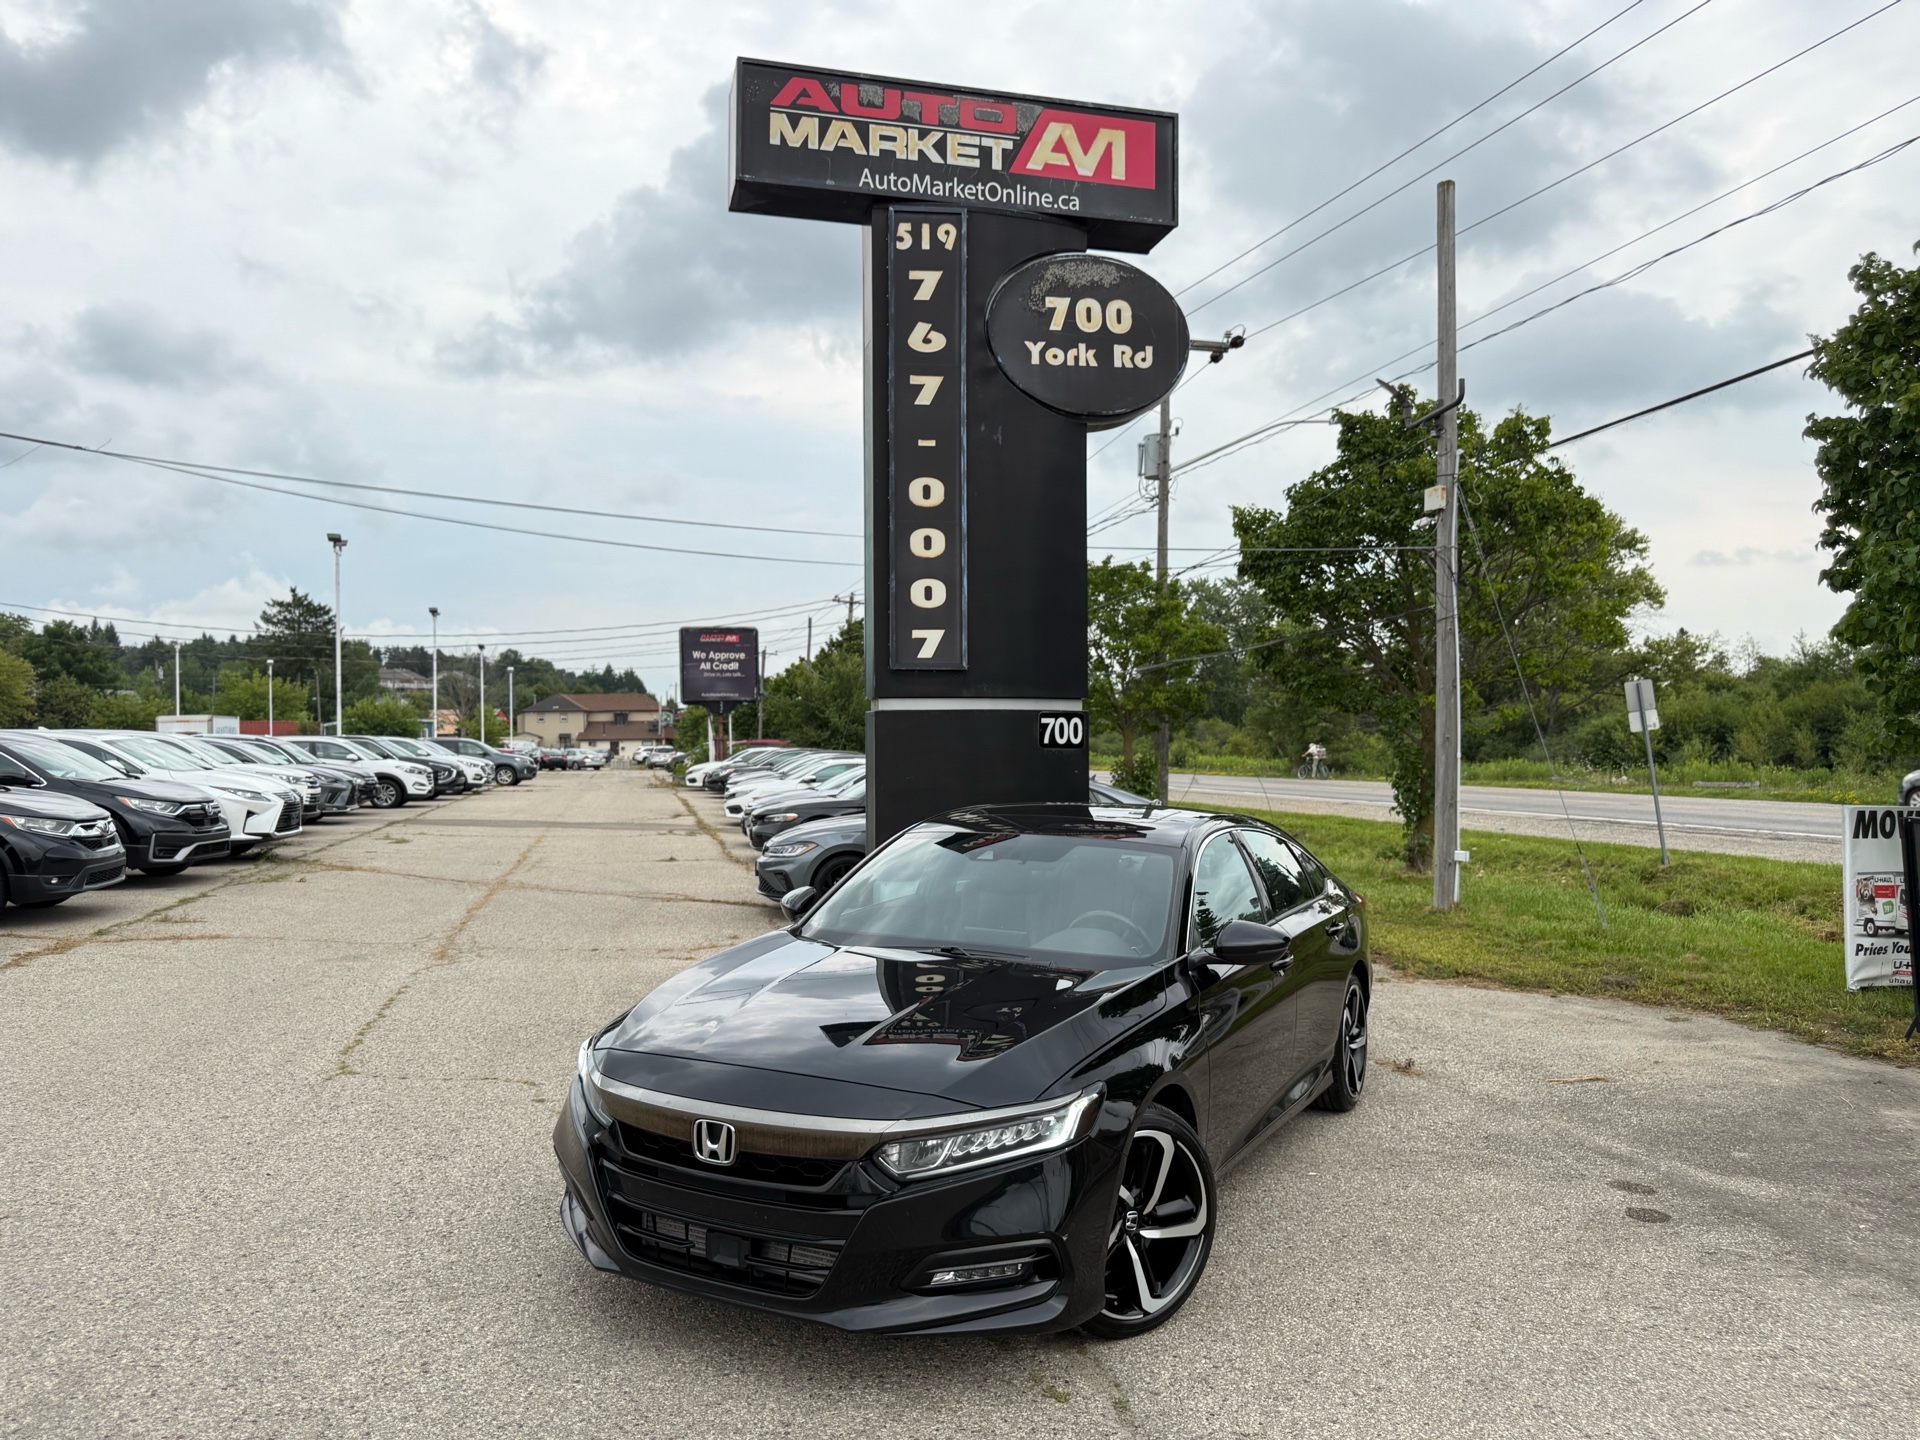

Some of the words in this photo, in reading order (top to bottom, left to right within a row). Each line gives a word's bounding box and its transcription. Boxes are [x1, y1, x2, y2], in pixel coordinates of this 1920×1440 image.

[769, 76, 1018, 134] AUTO
[769, 111, 1014, 171] MARKET
[1025, 121, 1126, 181] AM
[858, 167, 1081, 212] AutoMarketOnline.ca
[895, 222, 957, 251] 519
[1042, 296, 1133, 335] 700
[1024, 340, 1098, 367] York
[1113, 343, 1153, 369] Rd
[692, 651, 707, 659] We
[709, 651, 746, 661] Approve
[700, 662, 711, 670] All
[713, 662, 739, 670] Credit
[1041, 717, 1083, 745] 700
[1855, 942, 1889, 956] Prices
